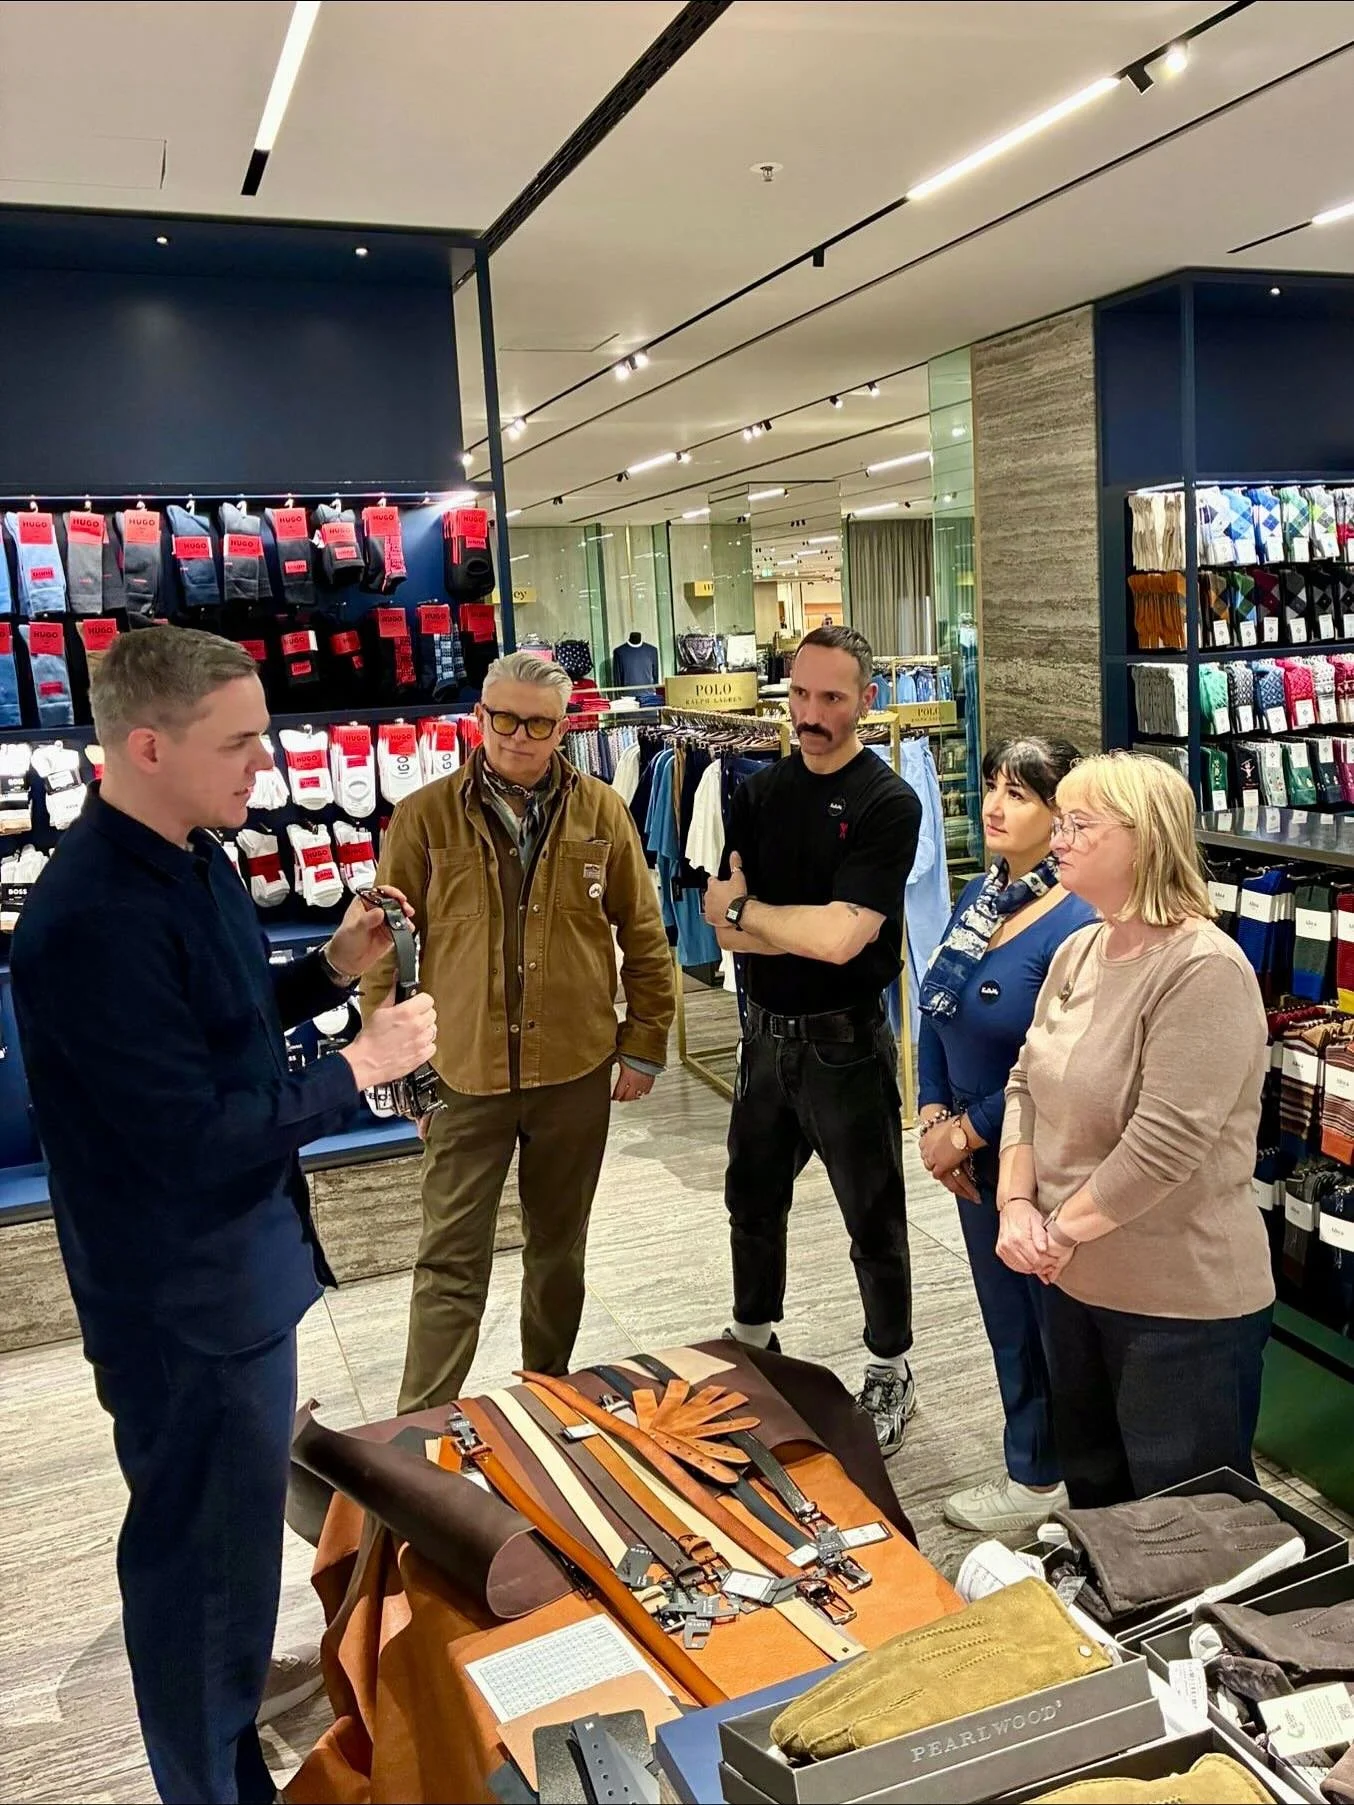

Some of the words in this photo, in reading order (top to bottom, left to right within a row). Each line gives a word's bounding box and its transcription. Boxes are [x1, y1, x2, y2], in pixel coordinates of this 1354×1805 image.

[73, 518, 100, 528] HUGO
[463, 515, 484, 523] HUGO
[230, 540, 254, 548] HUGO
[513, 590, 528, 600] ey
[695, 683, 732, 696] POLO
[306, 848, 328, 859] HUGO
